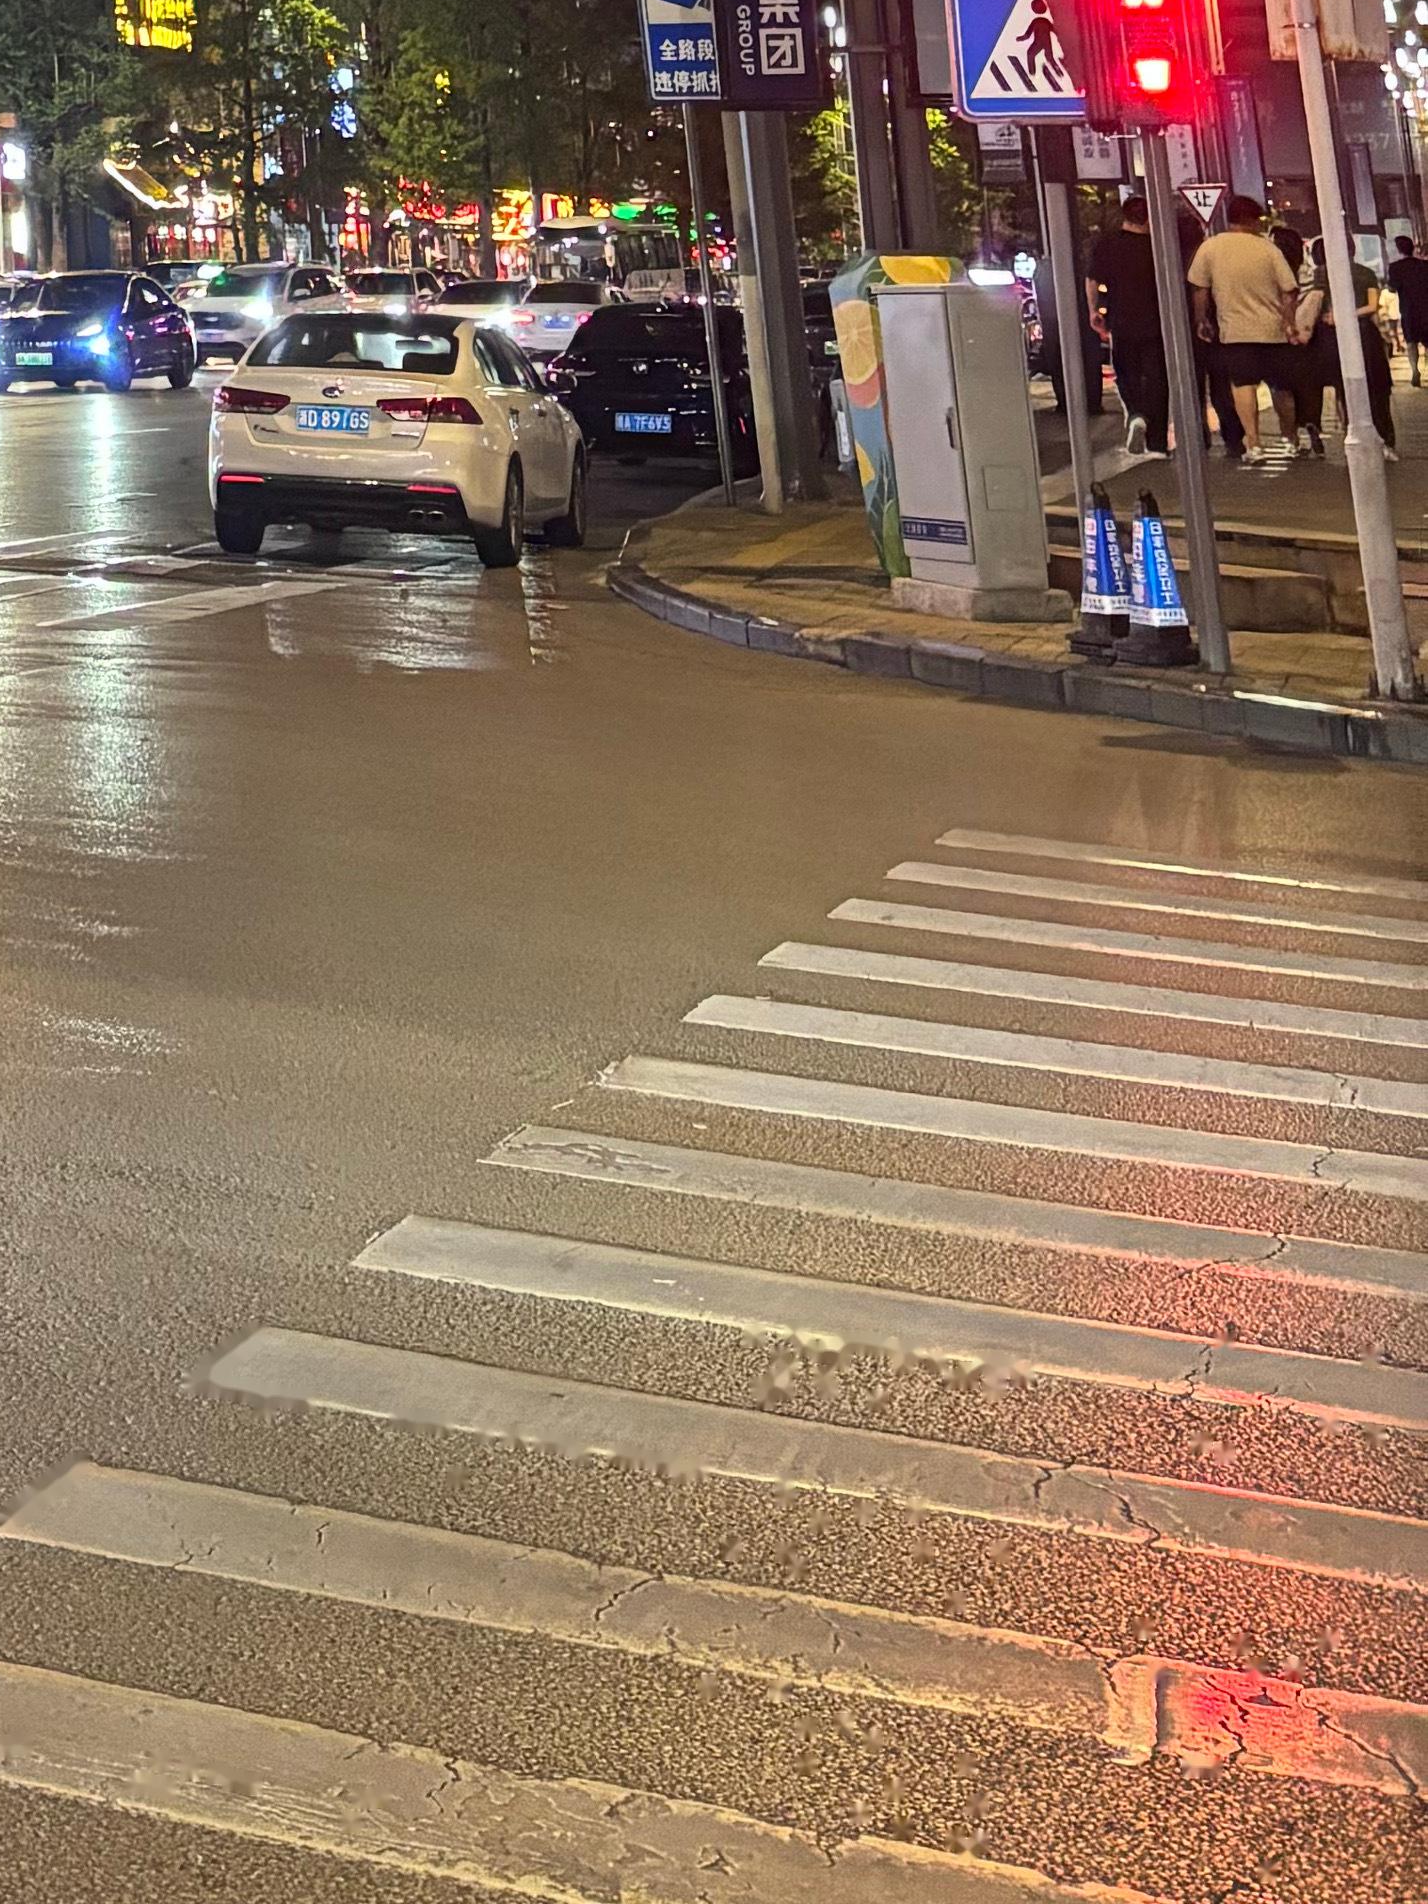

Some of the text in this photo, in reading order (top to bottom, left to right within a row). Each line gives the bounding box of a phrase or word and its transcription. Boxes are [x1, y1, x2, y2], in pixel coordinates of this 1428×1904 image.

[658, 38, 715, 62] 全路段
[736, 5, 755, 76] GROUP
[1193, 191, 1213, 208] 让
